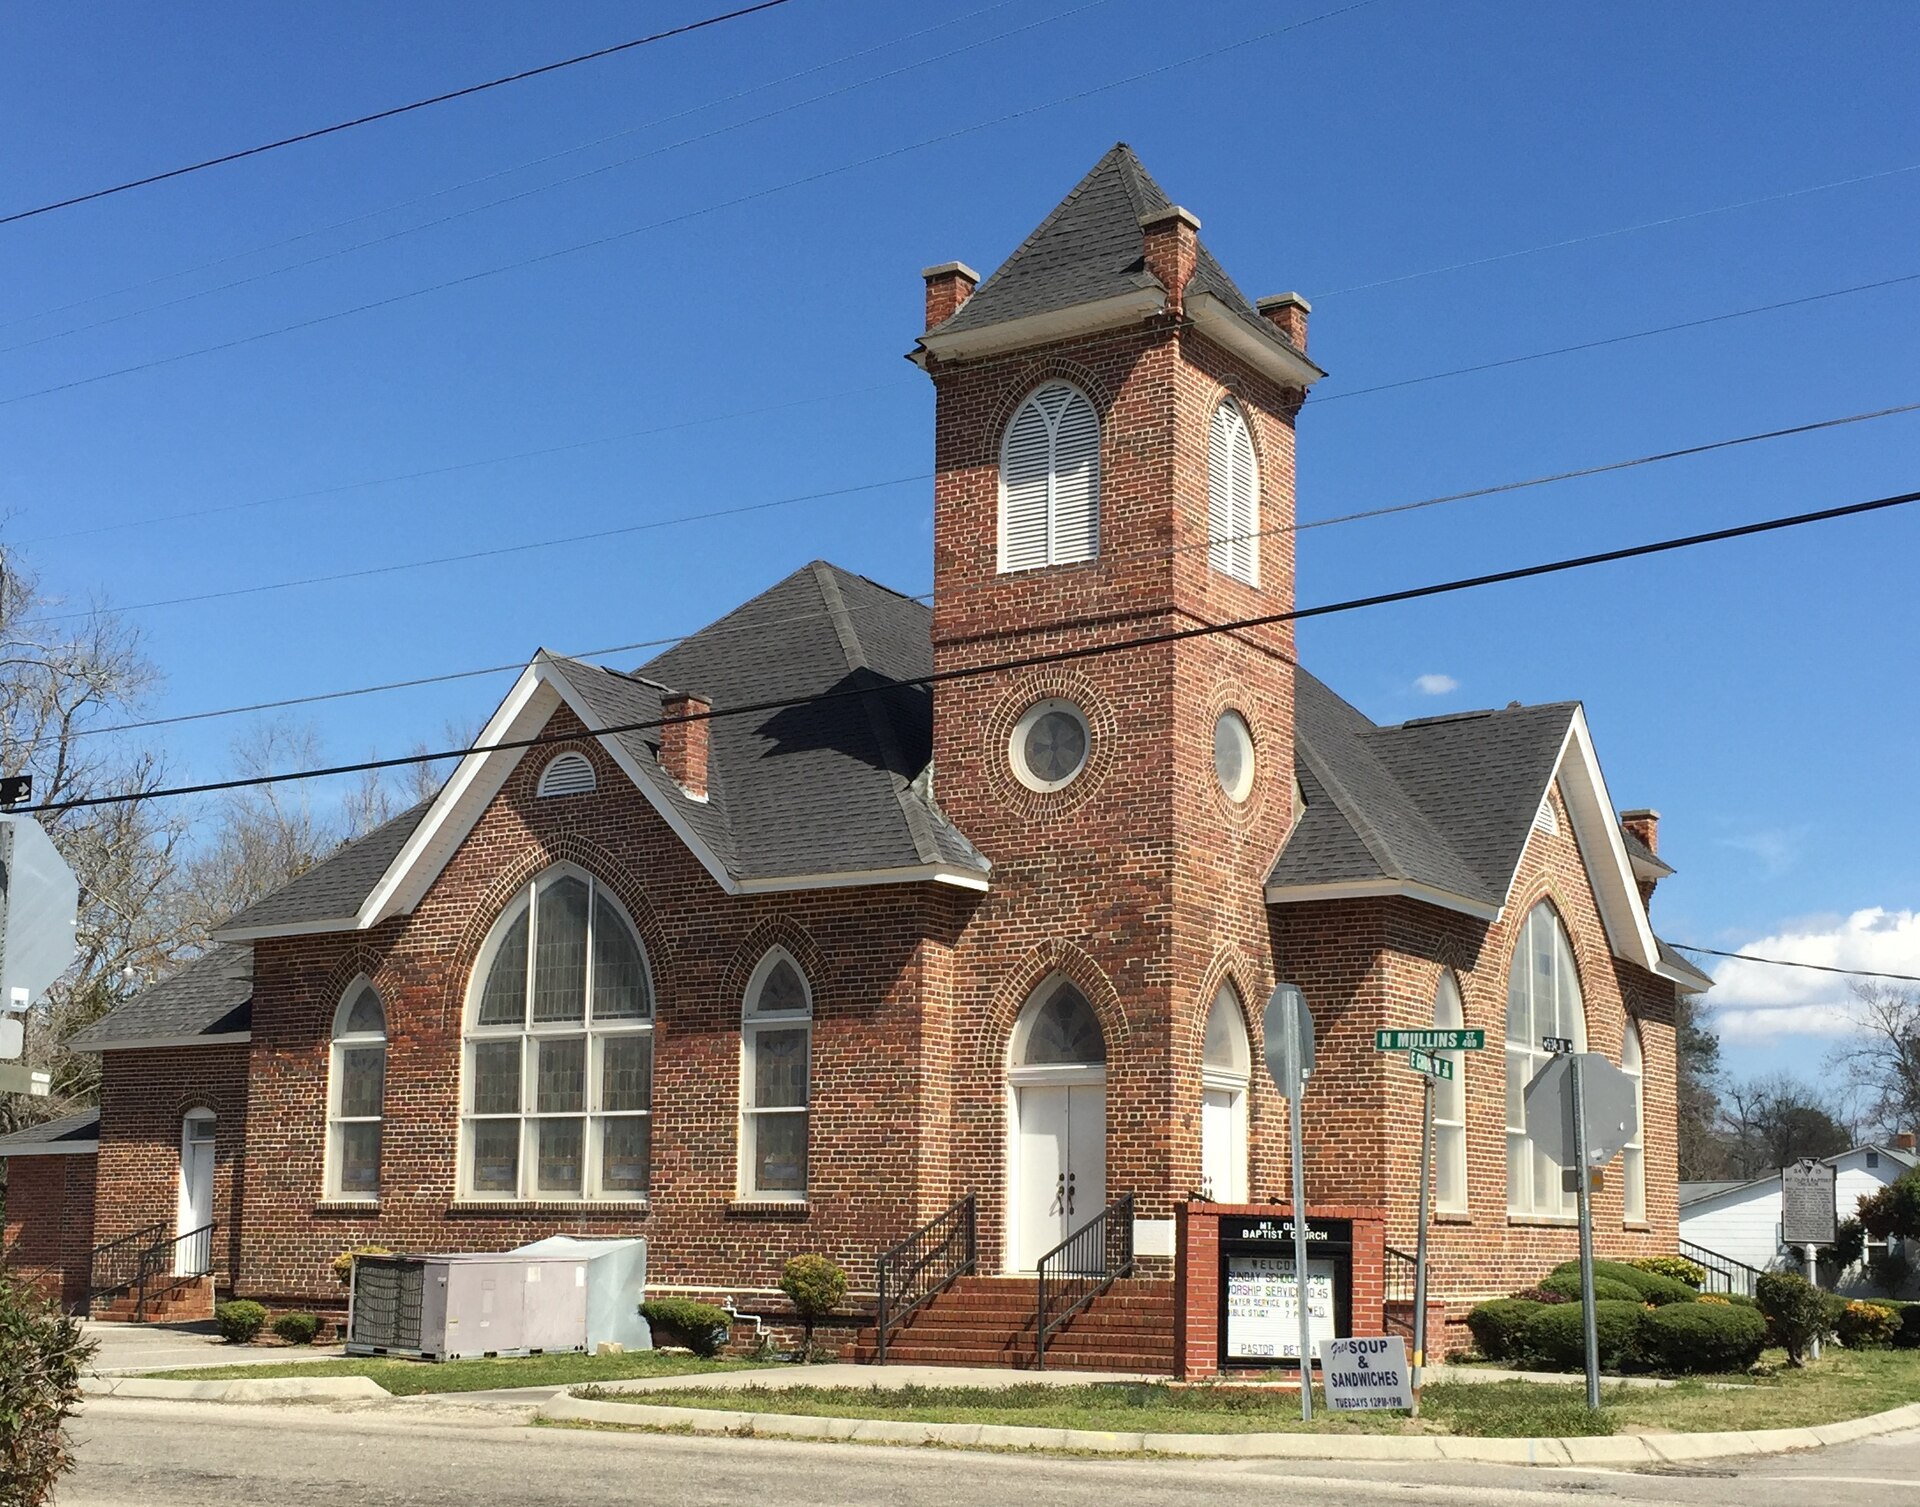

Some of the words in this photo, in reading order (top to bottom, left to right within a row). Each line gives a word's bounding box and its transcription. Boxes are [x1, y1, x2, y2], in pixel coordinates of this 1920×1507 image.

[1381, 1032, 1391, 1047] N
[1397, 1032, 1458, 1047] MULLINS
[1259, 1221, 1275, 1230] MT.
[1283, 1222, 1310, 1231] OLE
[1242, 1229, 1283, 1239] BAPTIST
[1290, 1231, 1328, 1240] CURCH
[1251, 1259, 1298, 1270] WELCO
[1228, 1271, 1260, 1283] SUNDAY
[1229, 1284, 1261, 1296] ORSHIP
[1229, 1297, 1250, 1306] RAYER
[1229, 1308, 1245, 1317] IBLE
[1241, 1344, 1274, 1355] PASTOR
[1283, 1344, 1317, 1356] BETA
[1349, 1340, 1388, 1354] SOUP
[1358, 1355, 1369, 1369] &
[1331, 1371, 1399, 1387] SANDWICHES
[1335, 1397, 1368, 1408] TUESDAYS
